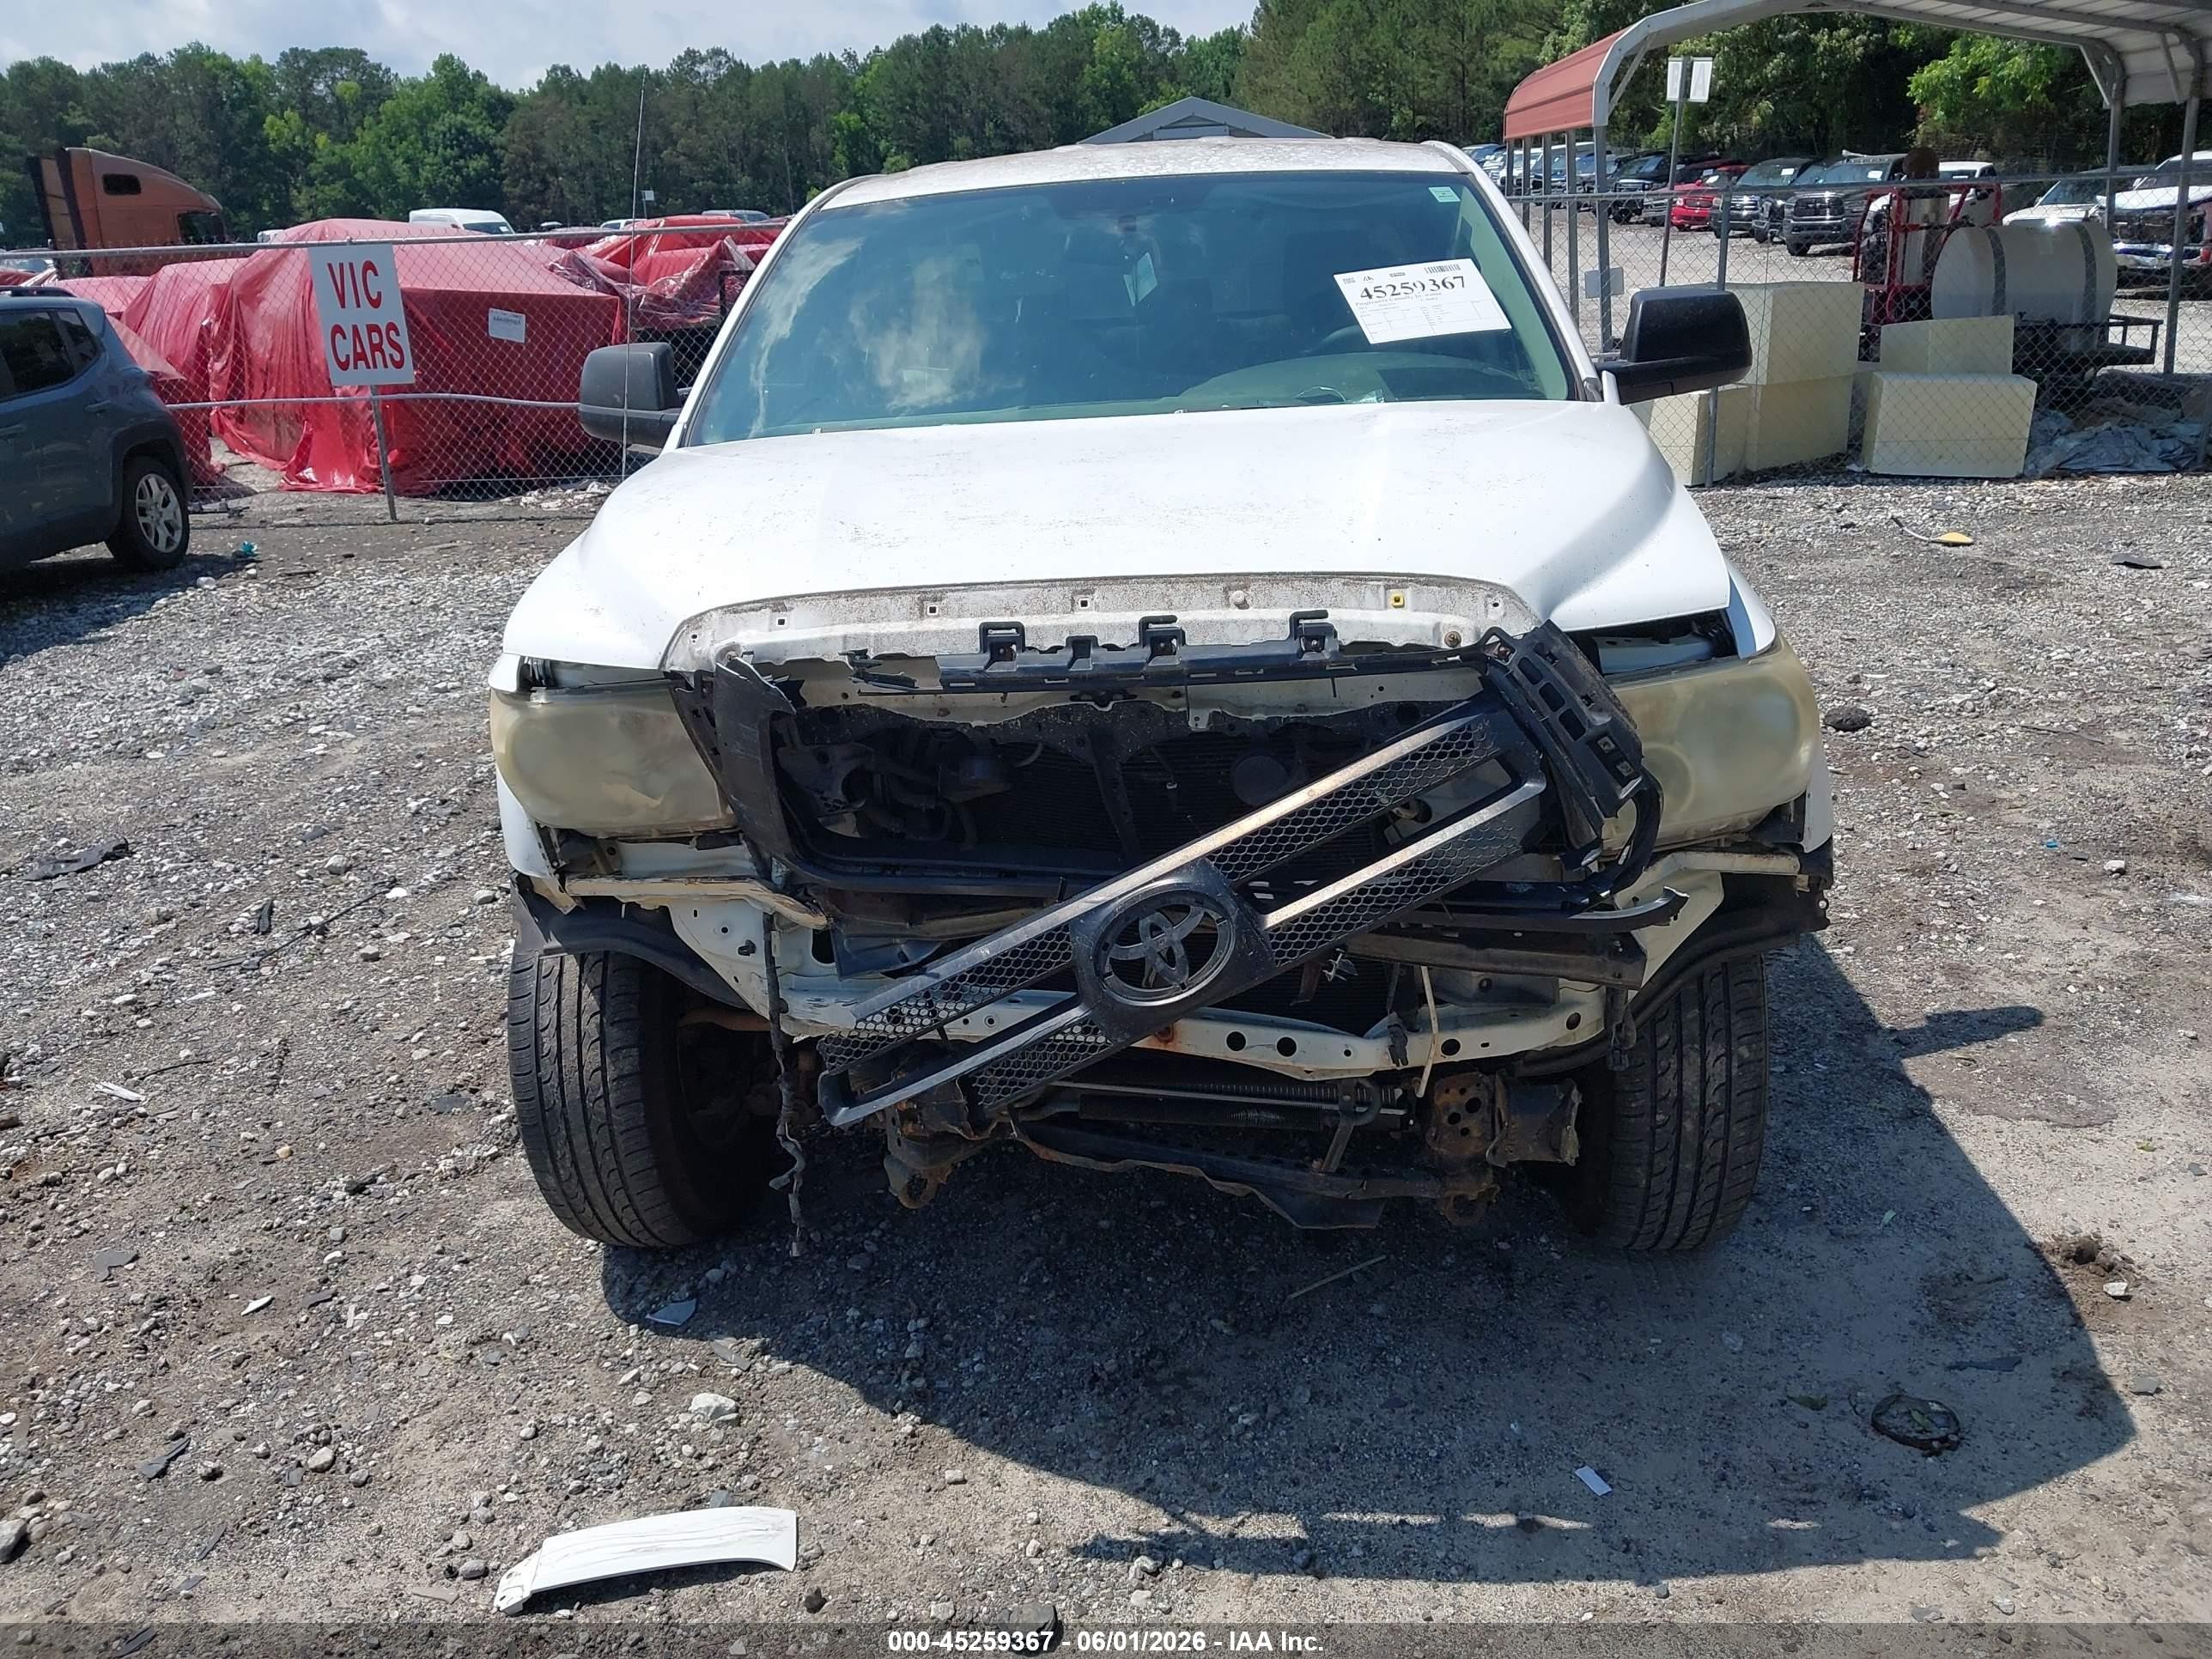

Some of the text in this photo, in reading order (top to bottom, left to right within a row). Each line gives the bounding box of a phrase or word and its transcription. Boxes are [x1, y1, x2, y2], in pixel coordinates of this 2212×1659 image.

[327, 261, 381, 308] VIC
[1359, 276, 1465, 300] 45259367
[331, 322, 404, 371] CARS
